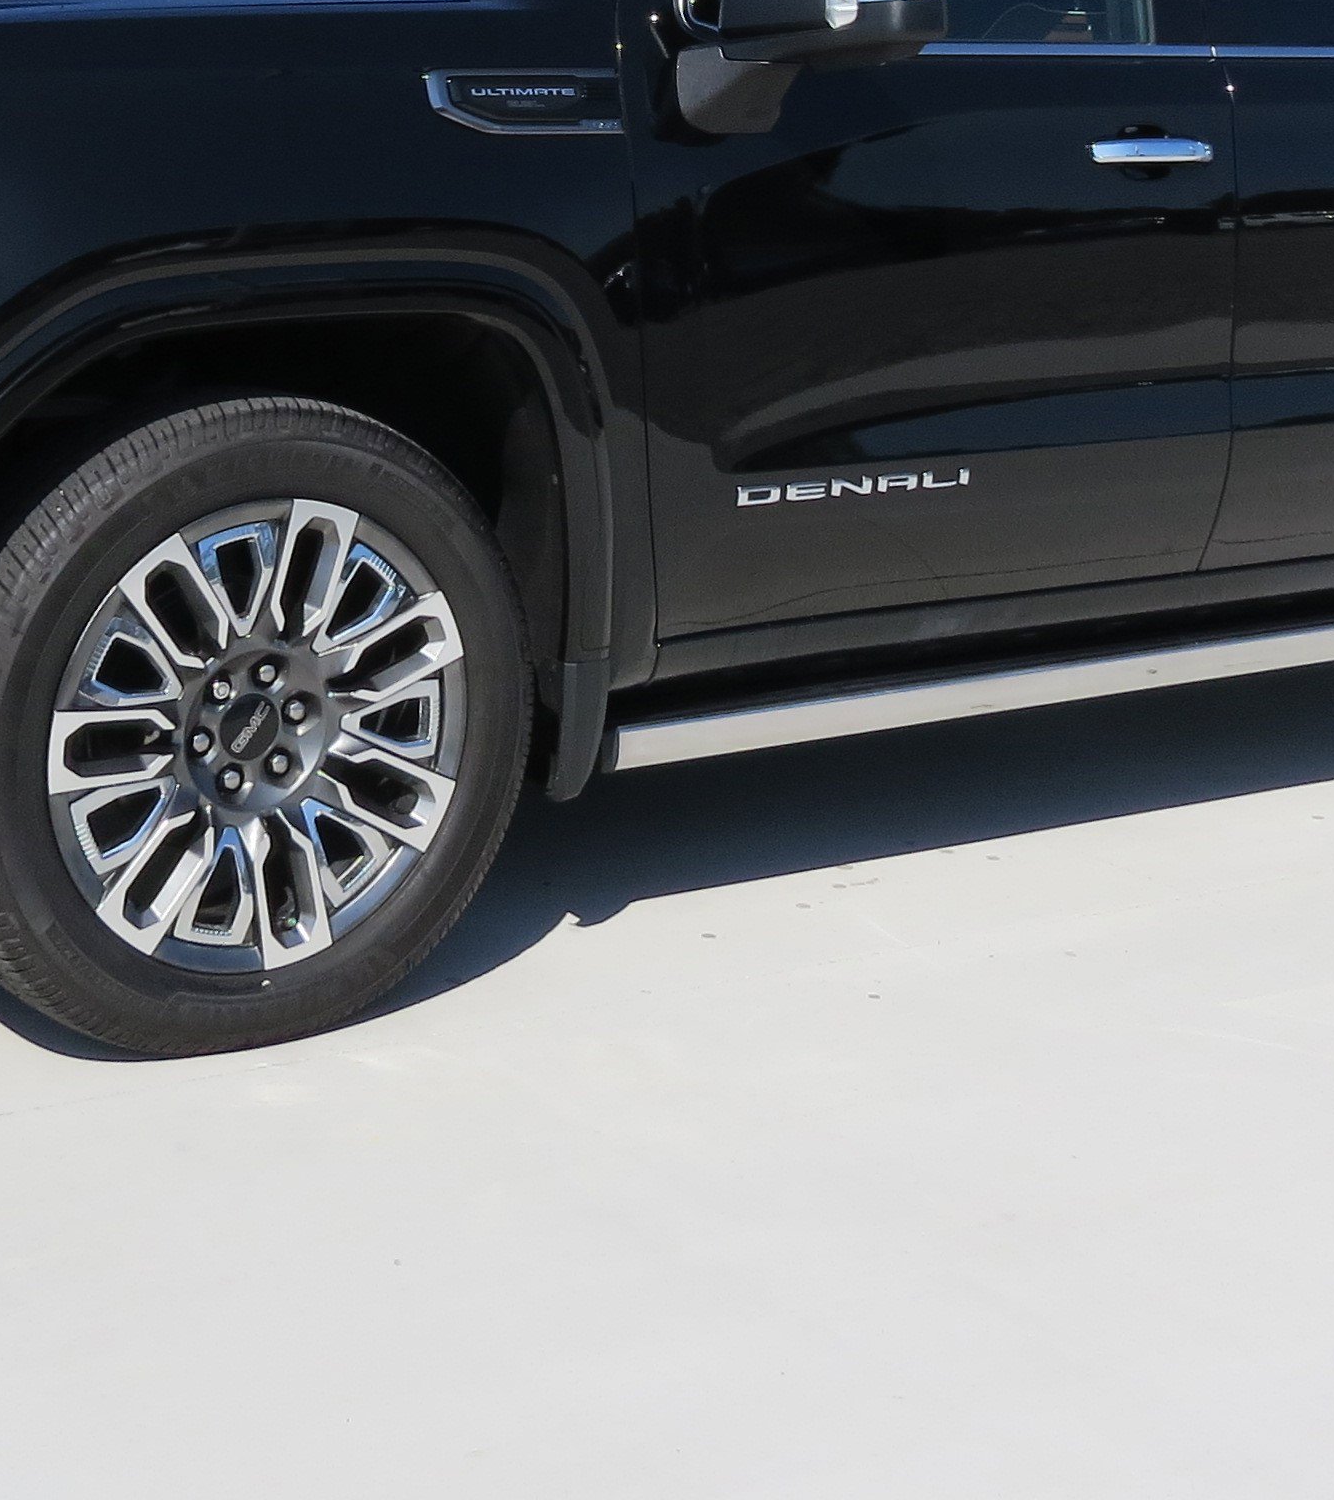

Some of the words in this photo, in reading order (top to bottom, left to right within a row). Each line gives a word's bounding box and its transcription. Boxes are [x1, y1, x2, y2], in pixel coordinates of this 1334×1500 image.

[470, 87, 576, 97] ULTIMATE
[736, 467, 970, 507] DENALI
[230, 700, 272, 754] GMC
